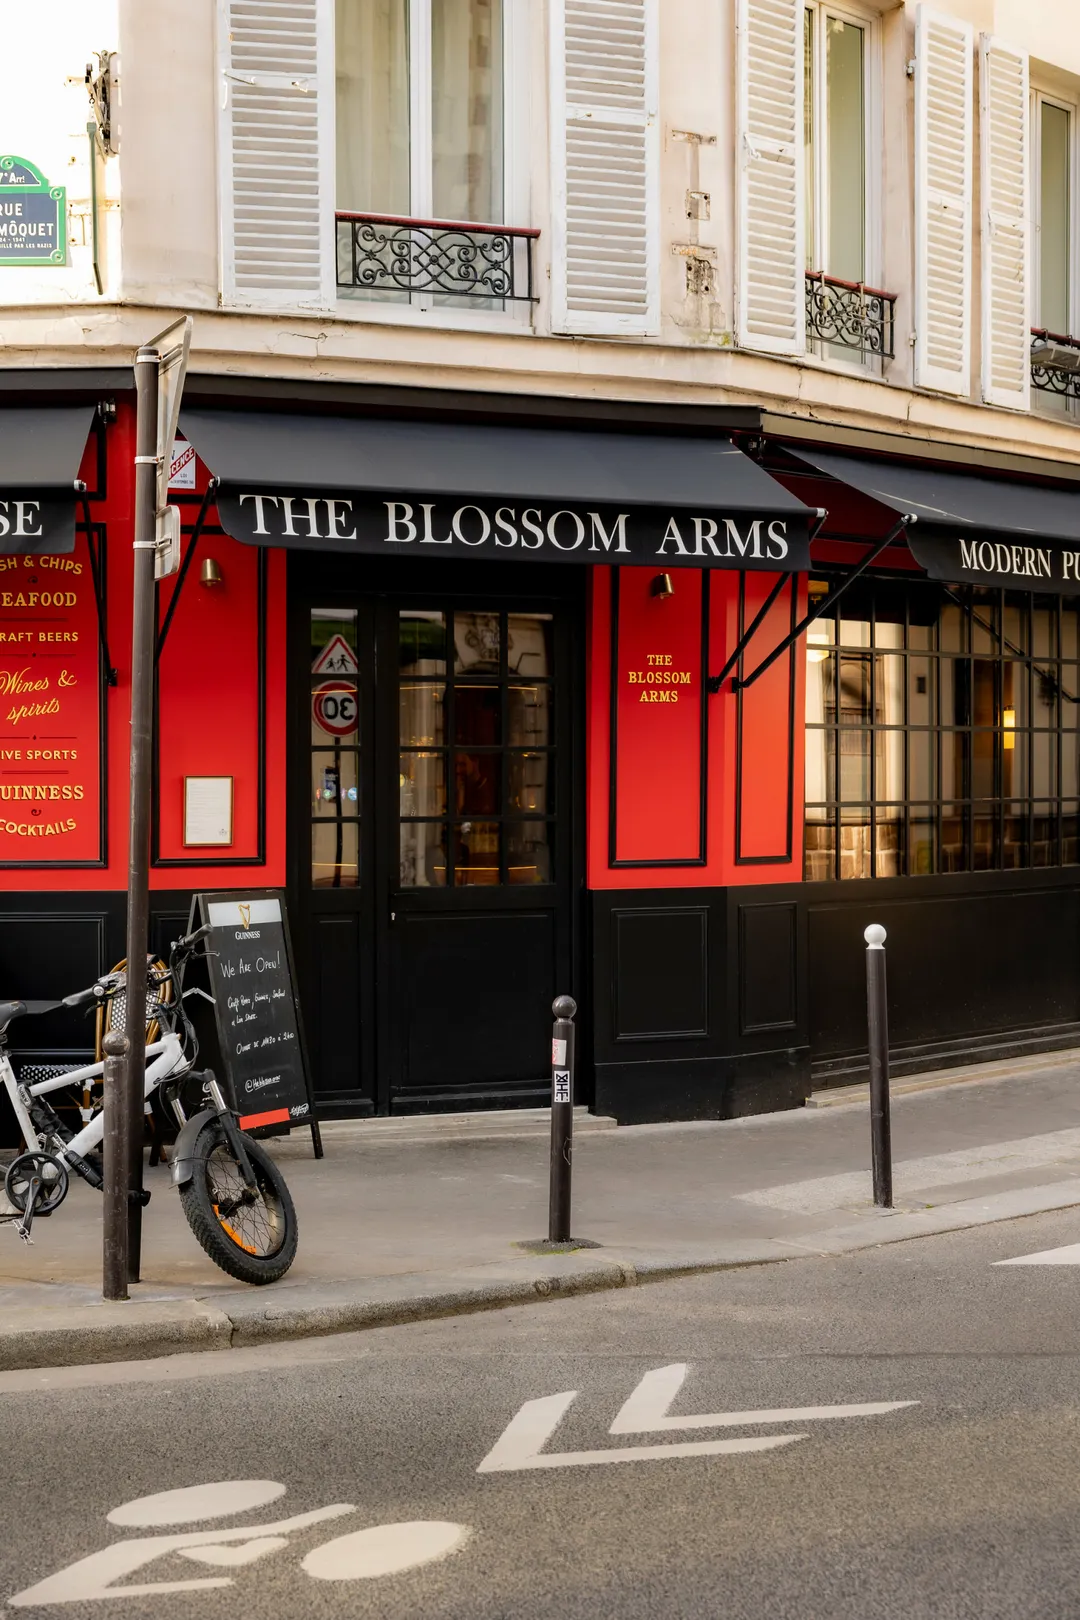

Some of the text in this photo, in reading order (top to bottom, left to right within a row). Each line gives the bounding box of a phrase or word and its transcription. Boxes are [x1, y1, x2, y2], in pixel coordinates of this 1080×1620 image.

[0, 220, 54, 237] MÔQUET
[239, 494, 789, 560] THE BLOSSOM ARMS
[23, 555, 35, 568] &
[39, 556, 83, 575] CHIPS
[959, 539, 1052, 578] MODERN
[1, 592, 77, 607] EAFOOD
[0, 632, 79, 642] RAFT BEERS
[647, 655, 672, 666] THE
[0, 667, 77, 695] Wines &
[628, 672, 691, 684] BLOSSOM
[639, 691, 678, 702] ARMS
[6, 698, 60, 725] spirits
[1, 750, 77, 760] IVE SPORTS
[0, 785, 84, 800] UINNESS
[235, 931, 260, 940] GUINNESS
